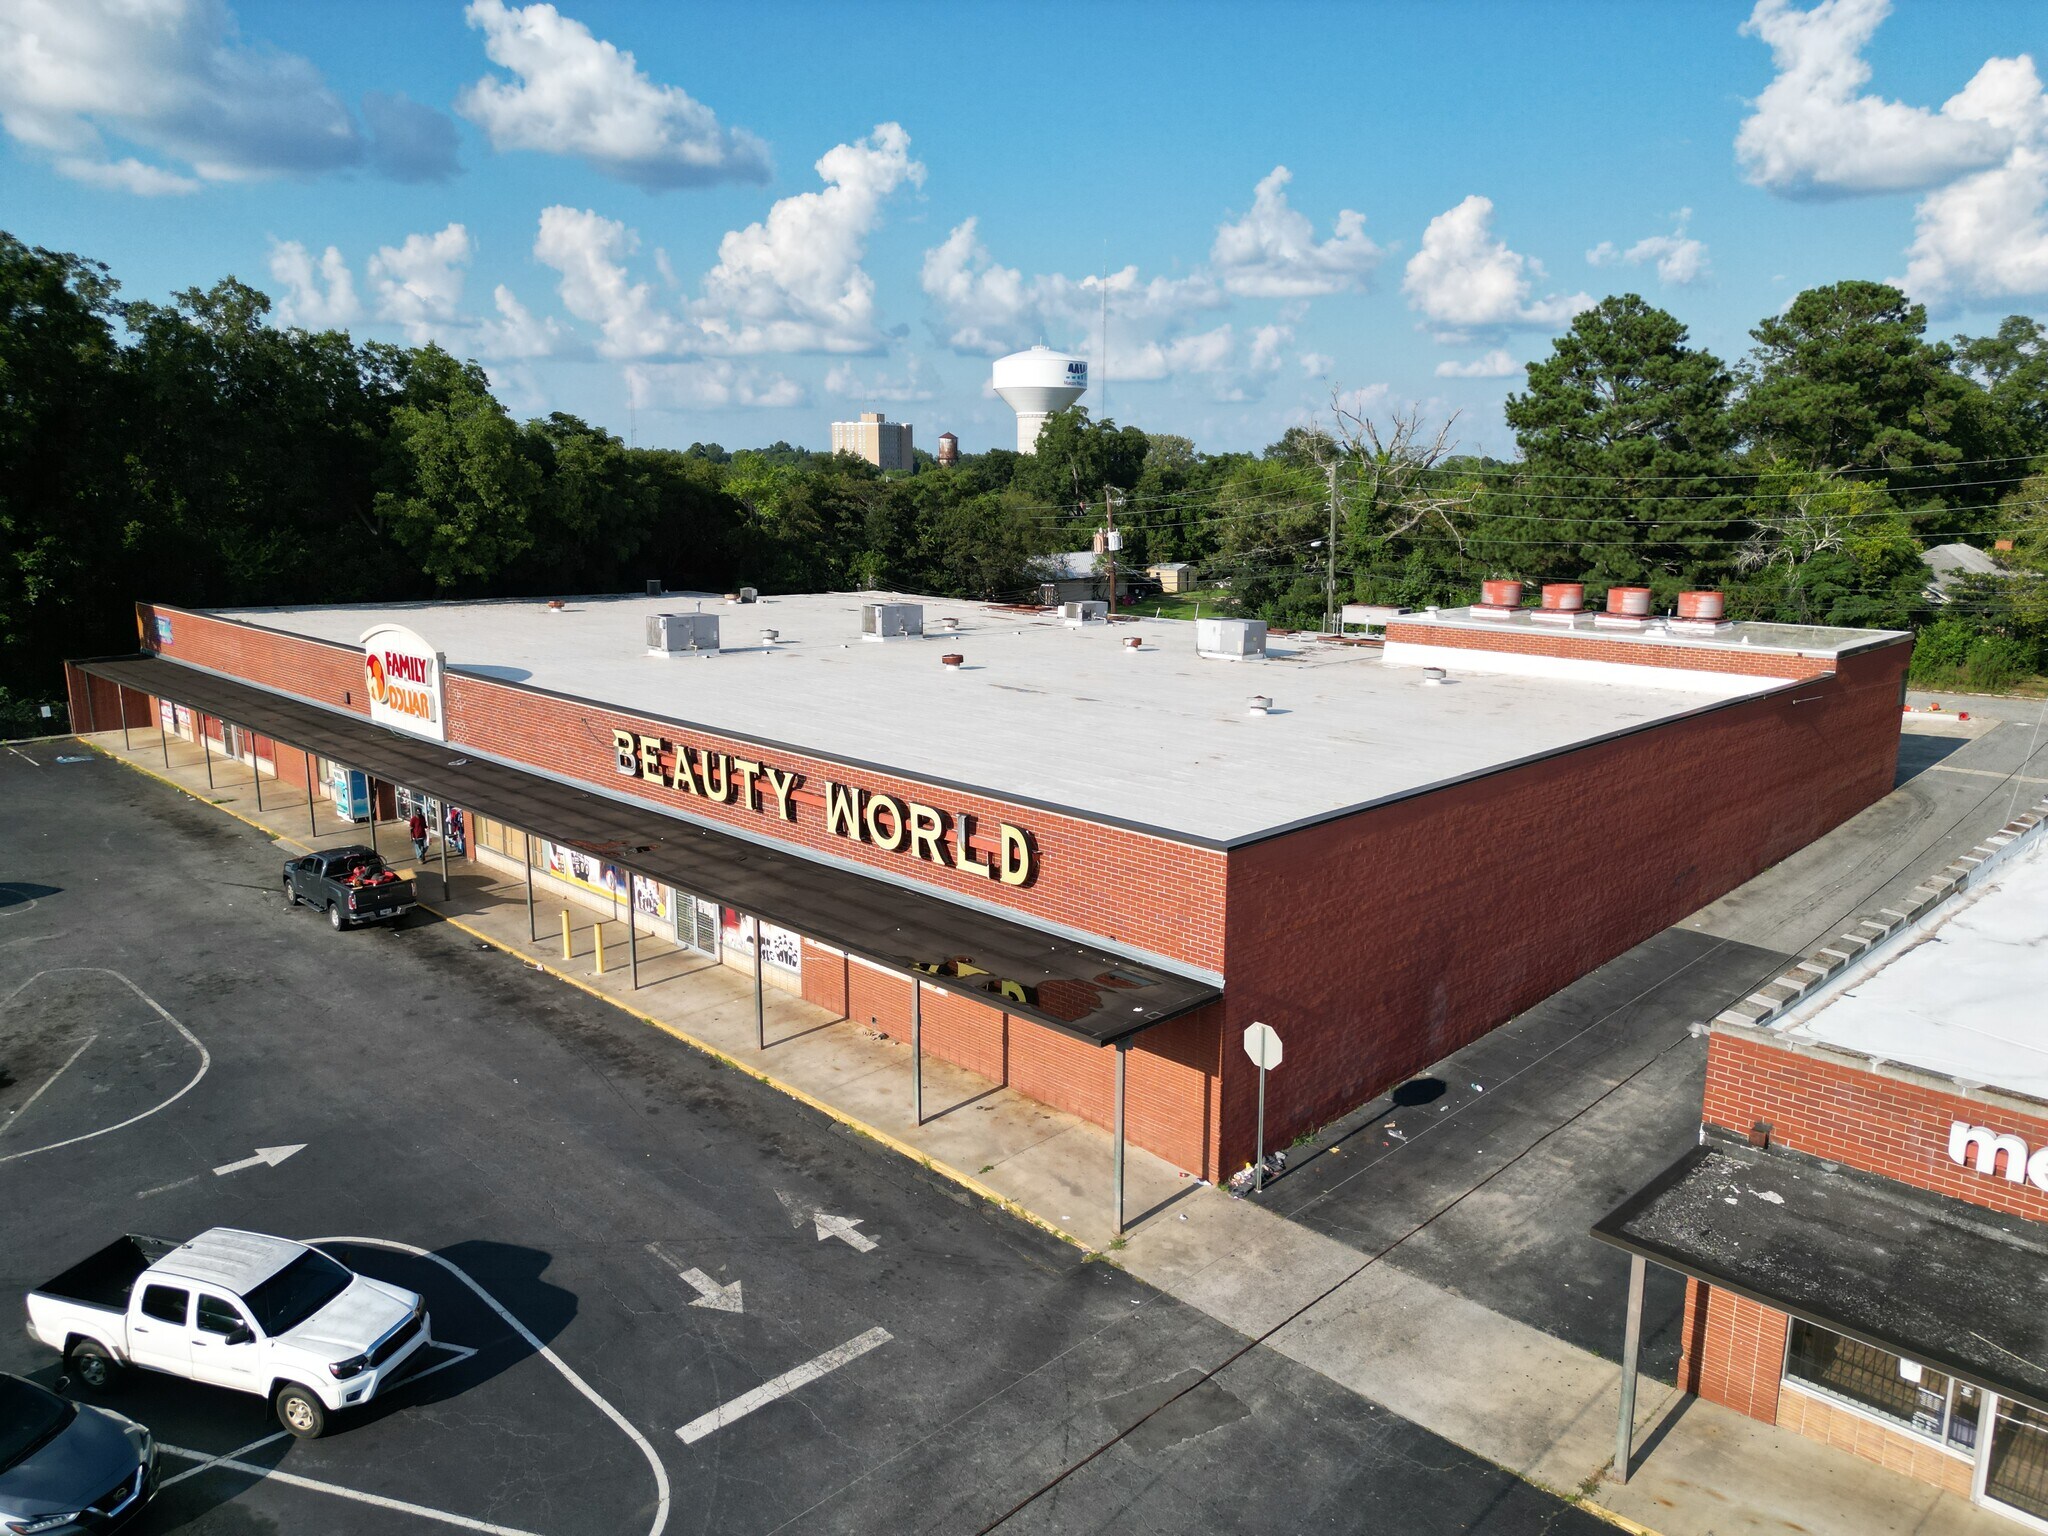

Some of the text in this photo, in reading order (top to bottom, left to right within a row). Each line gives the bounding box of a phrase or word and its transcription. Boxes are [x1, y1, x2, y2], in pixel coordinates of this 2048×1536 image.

[385, 651, 427, 684] FAMILY
[612, 729, 1037, 887] BEAUTY WORLD
